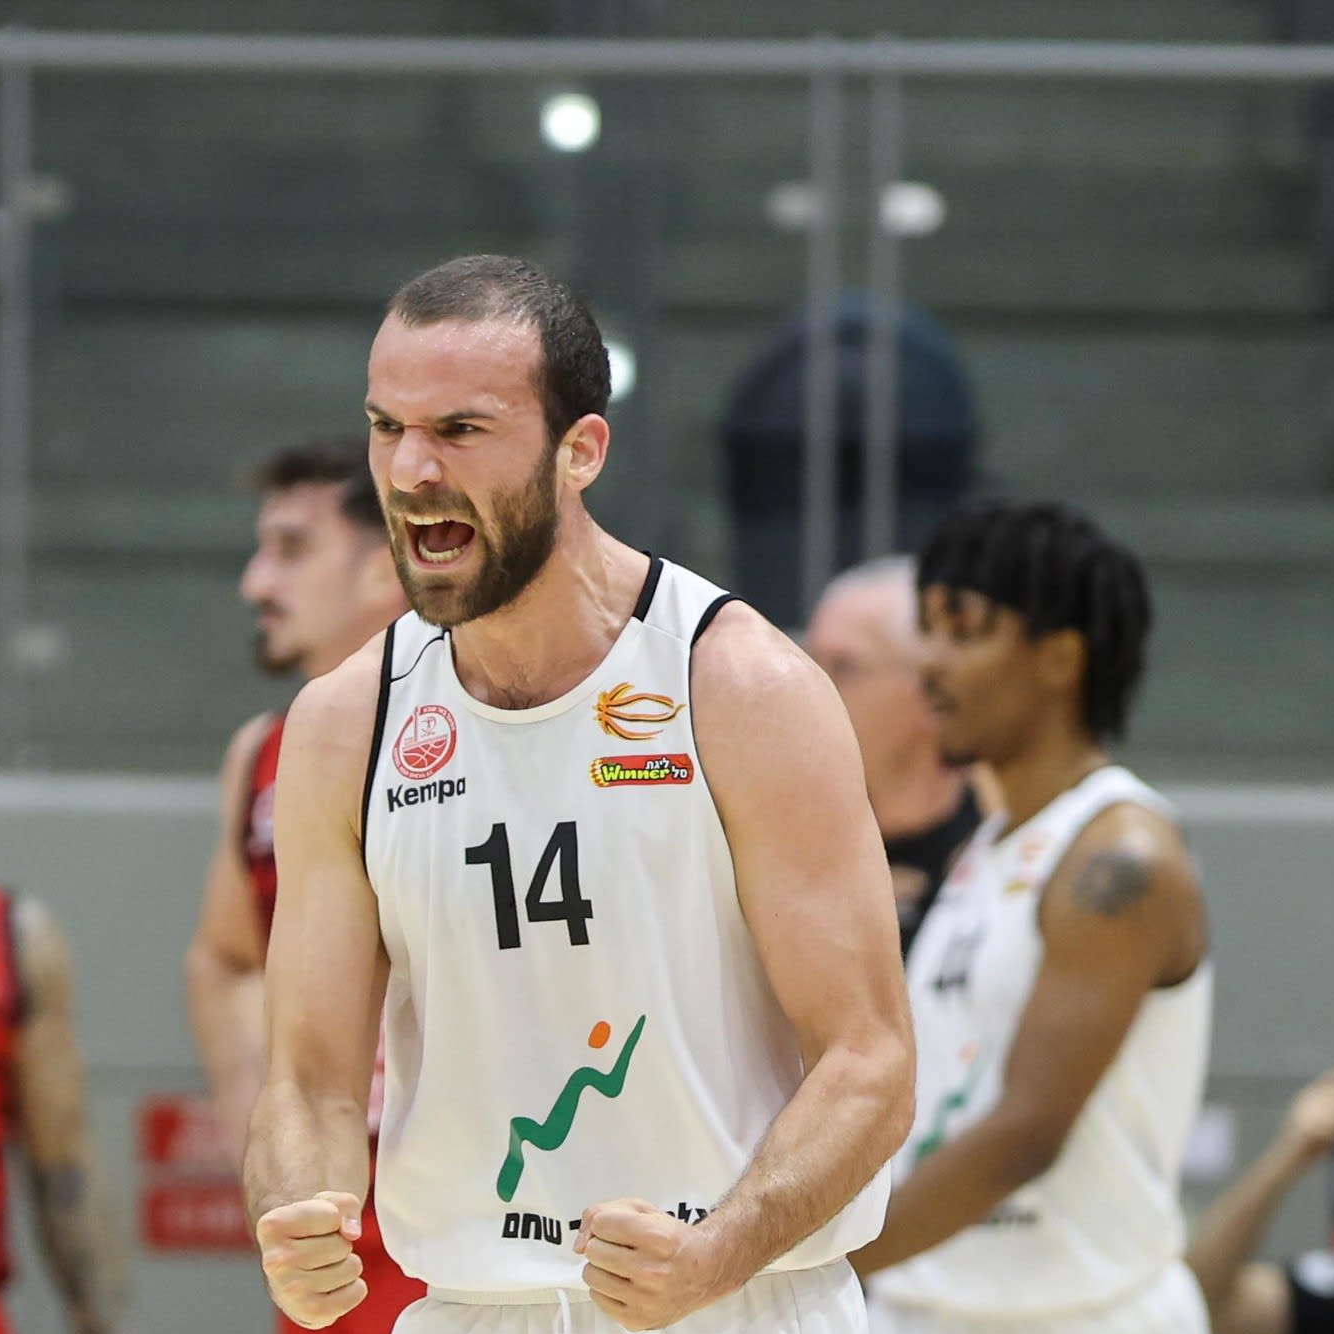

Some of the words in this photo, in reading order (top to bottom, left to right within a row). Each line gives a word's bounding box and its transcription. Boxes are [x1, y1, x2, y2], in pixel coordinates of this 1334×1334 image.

[601, 764, 671, 781] Winner
[671, 765, 688, 779] סל
[387, 777, 466, 813] Kempa
[465, 821, 594, 950] 14
[502, 1212, 563, 1246] שחם
